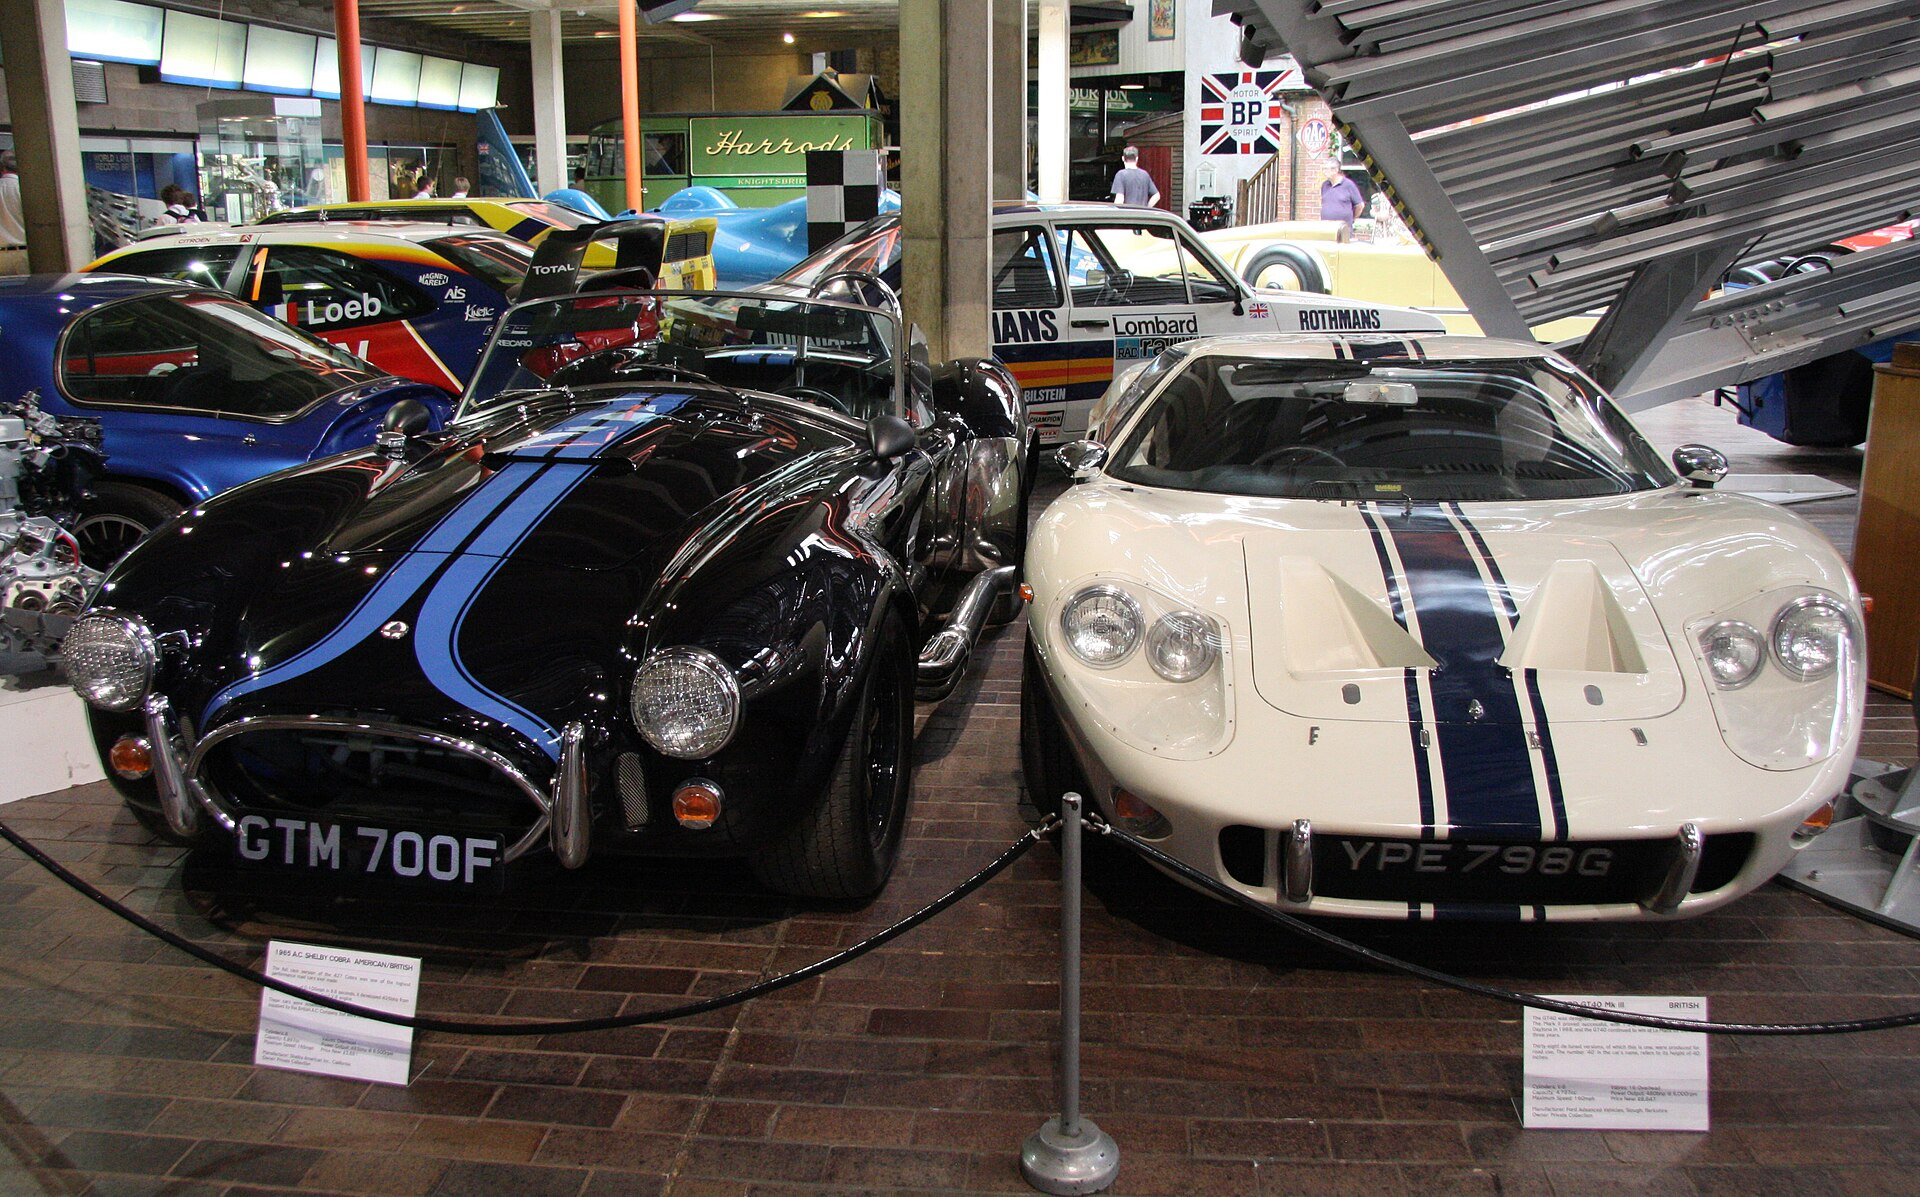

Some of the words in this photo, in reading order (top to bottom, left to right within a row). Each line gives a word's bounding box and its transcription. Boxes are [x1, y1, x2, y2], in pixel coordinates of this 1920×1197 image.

[706, 130, 854, 156] Harrods
[1232, 128, 1259, 137] SPIRIT
[252, 247, 269, 301] 1
[533, 263, 575, 275] TOTAL
[308, 292, 382, 325] Loeb
[1112, 314, 1199, 336] Lombard
[1299, 309, 1381, 331] ROTHMANS
[1117, 347, 1138, 359] RAC
[1024, 388, 1066, 402] BILSTEIN
[1029, 415, 1062, 423] CHAMPION
[239, 814, 341, 870] GTM
[357, 826, 498, 884] 700F
[1341, 840, 1453, 872] YPE
[1461, 844, 1614, 876] 798G
[305, 951, 327, 960] SHELBY
[328, 955, 351, 964] COBRA
